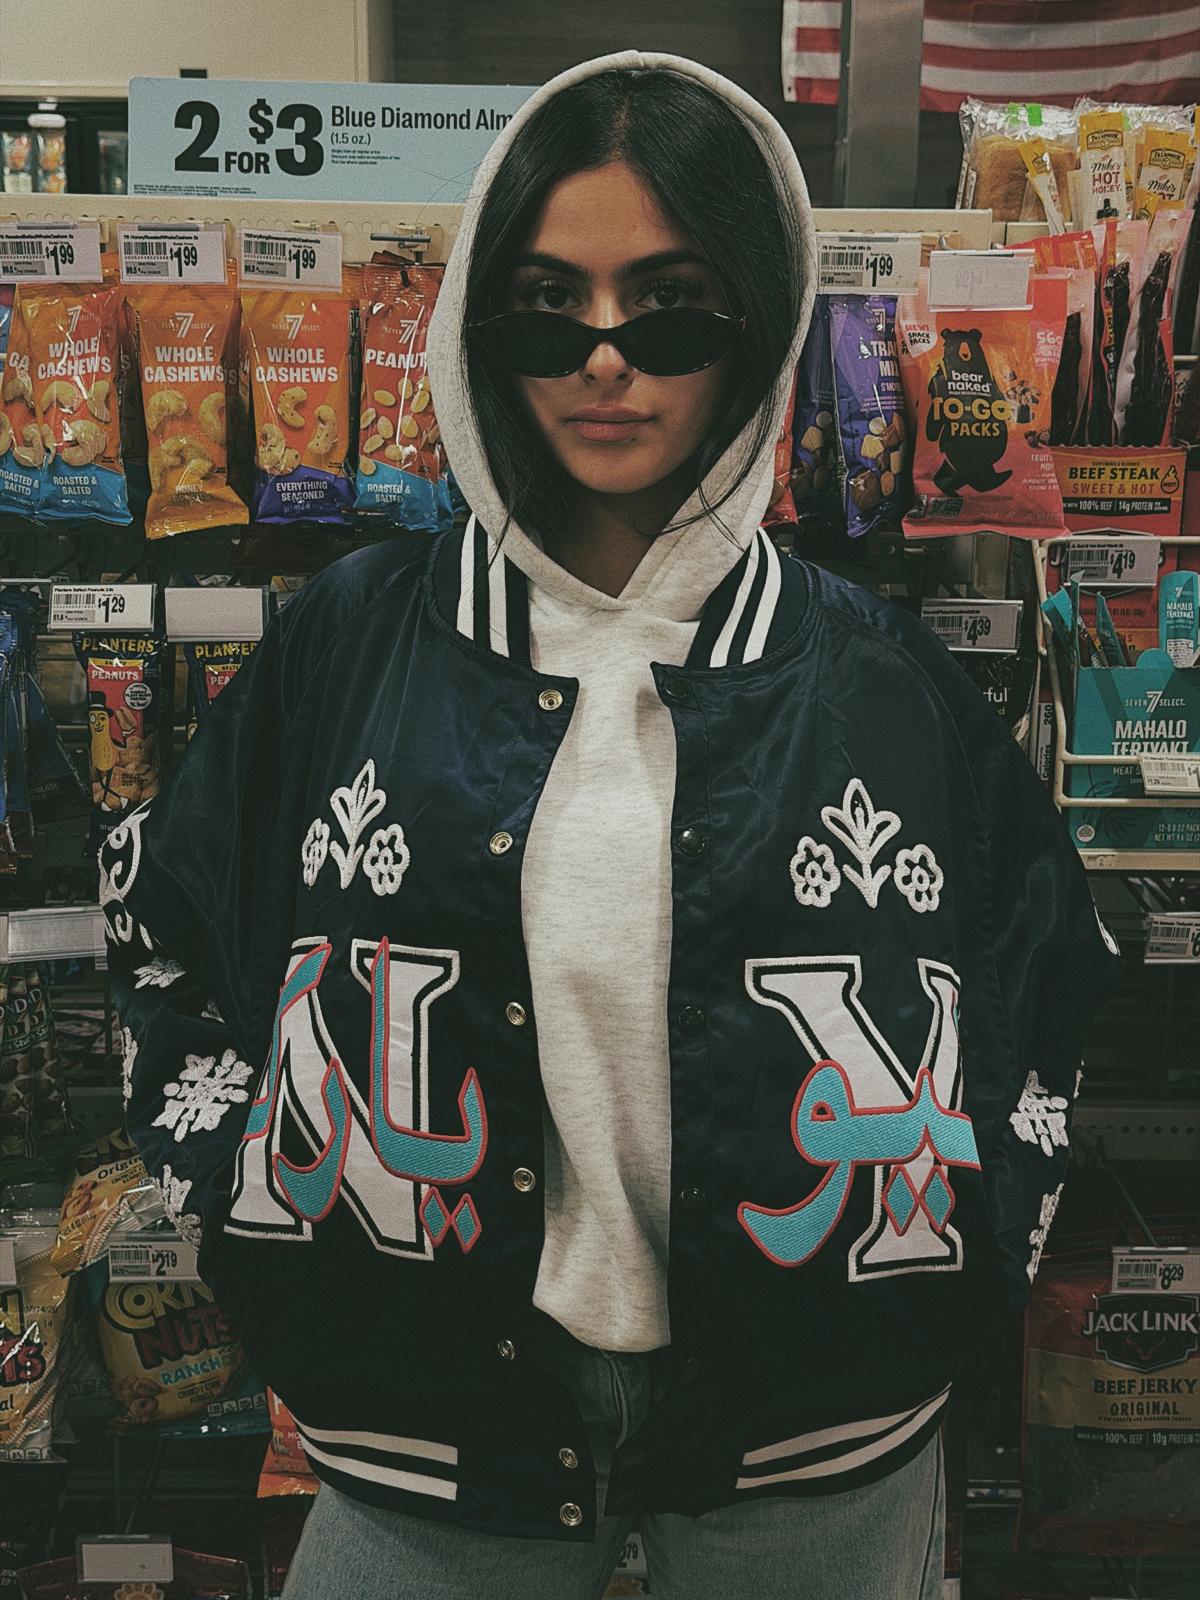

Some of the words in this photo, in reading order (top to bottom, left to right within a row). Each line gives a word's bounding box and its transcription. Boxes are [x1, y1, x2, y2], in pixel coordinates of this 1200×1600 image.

[331, 106, 376, 128] Blue
[381, 107, 470, 130] Diamond
[174, 100, 220, 172] 2
[224, 151, 270, 174] FOR
[248, 98, 324, 176] $3
[330, 133, 349, 145] (1.5
[351, 133, 371, 145] oz.)
[1093, 172, 1121, 187] HOT
[48, 337, 98, 358] WHOLE
[155, 345, 214, 363] WHOLE
[266, 347, 325, 364] WHOLE
[38, 356, 112, 379] CASHEWS
[144, 365, 224, 383] CASHEWS
[255, 365, 338, 383] CASHEWS
[952, 370, 983, 383] bear
[947, 381, 991, 393] naked
[932, 397, 1010, 420] TO-GO
[950, 422, 1001, 437] PACKS
[52, 476, 90, 485] ROASTED
[1068, 467, 1110, 480] BEEF
[1113, 467, 1160, 480] STEAK
[4, 480, 31, 495] SALTED
[62, 485, 92, 495] SALTED
[276, 481, 328, 492] EVERYTHING
[367, 483, 403, 493] ROASTED
[1072, 483, 1114, 495] SWEET
[1118, 483, 1126, 494] &
[1131, 483, 1154, 494] HOT
[281, 491, 325, 502] SEASONED
[1079, 501, 1099, 510] 100%
[1100, 502, 1112, 510] BEEF
[1131, 502, 1153, 510] PROTEIN
[82, 637, 154, 653] PLANTERS
[92, 670, 139, 680] PEANUTS
[982, 687, 1008, 702] ful
[1124, 698, 1147, 707] SEVEN
[1115, 719, 1188, 739] MAHALO
[1113, 766, 1134, 776] MEAT
[1082, 1311, 1140, 1336] JACK
[134, 1305, 241, 1370] NUTS
[160, 1356, 224, 1386] RANCH
[1093, 1379, 1137, 1395] BEEF
[1138, 1378, 1199, 1395] JERKY
[1110, 1401, 1180, 1416] ORIGINAL
[1105, 1432, 1127, 1444] 100%
[1128, 1433, 1144, 1444] BEEF
[1168, 1432, 1194, 1444] PROTEIN
